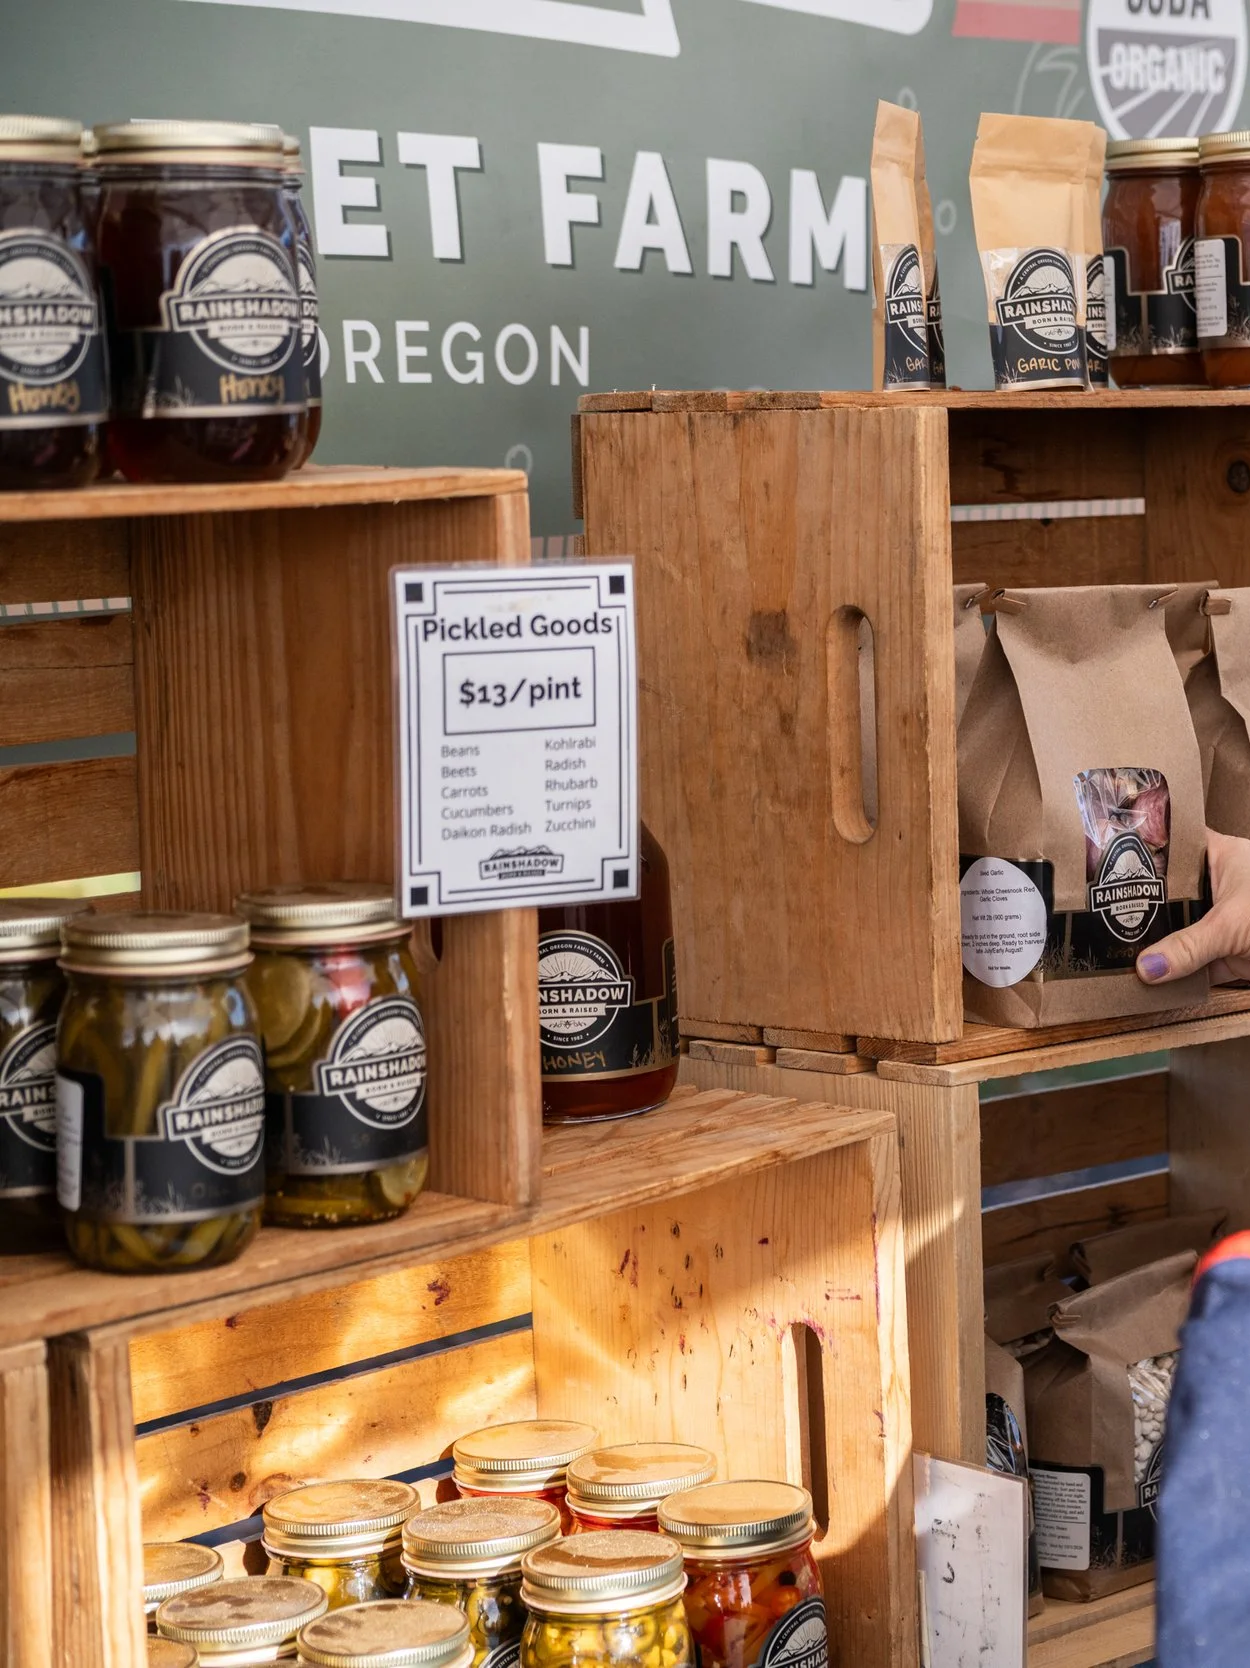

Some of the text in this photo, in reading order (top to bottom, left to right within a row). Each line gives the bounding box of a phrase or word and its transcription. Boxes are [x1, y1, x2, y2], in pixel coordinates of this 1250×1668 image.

[1109, 42, 1226, 94] ORGANIC
[309, 126, 867, 291] ET FARM
[0, 305, 92, 325] NSHADOW
[889, 299, 922, 317] RAINS
[1004, 299, 1074, 319] RAINSHAD
[319, 319, 589, 387] REGON
[422, 611, 613, 642] Pickled Goods
[459, 676, 582, 709] $13/pint
[440, 745, 480, 759] Beans
[544, 736, 597, 751] Kohlrabi
[440, 765, 477, 779] Beets
[544, 757, 587, 772] Radish
[440, 785, 489, 800] Carrots
[544, 776, 599, 792] Rhubarb
[440, 803, 514, 820] Cucumbers
[544, 798, 592, 814] Turnips
[440, 820, 532, 841] Daikon Radish
[545, 816, 597, 833] Zucchini
[484, 858, 560, 873] RAINSHADOW
[1096, 884, 1160, 904] RAINSHADOW
[998, 933, 1017, 941] ground,
[1001, 940, 1017, 948] Ready
[573, 943, 593, 955] FAMILY
[592, 951, 605, 964] FARM
[538, 986, 625, 1003] NSHADOW
[569, 1005, 599, 1013] RAISED
[543, 1050, 607, 1071] HONEY
[0, 1086, 57, 1108] RAINS
